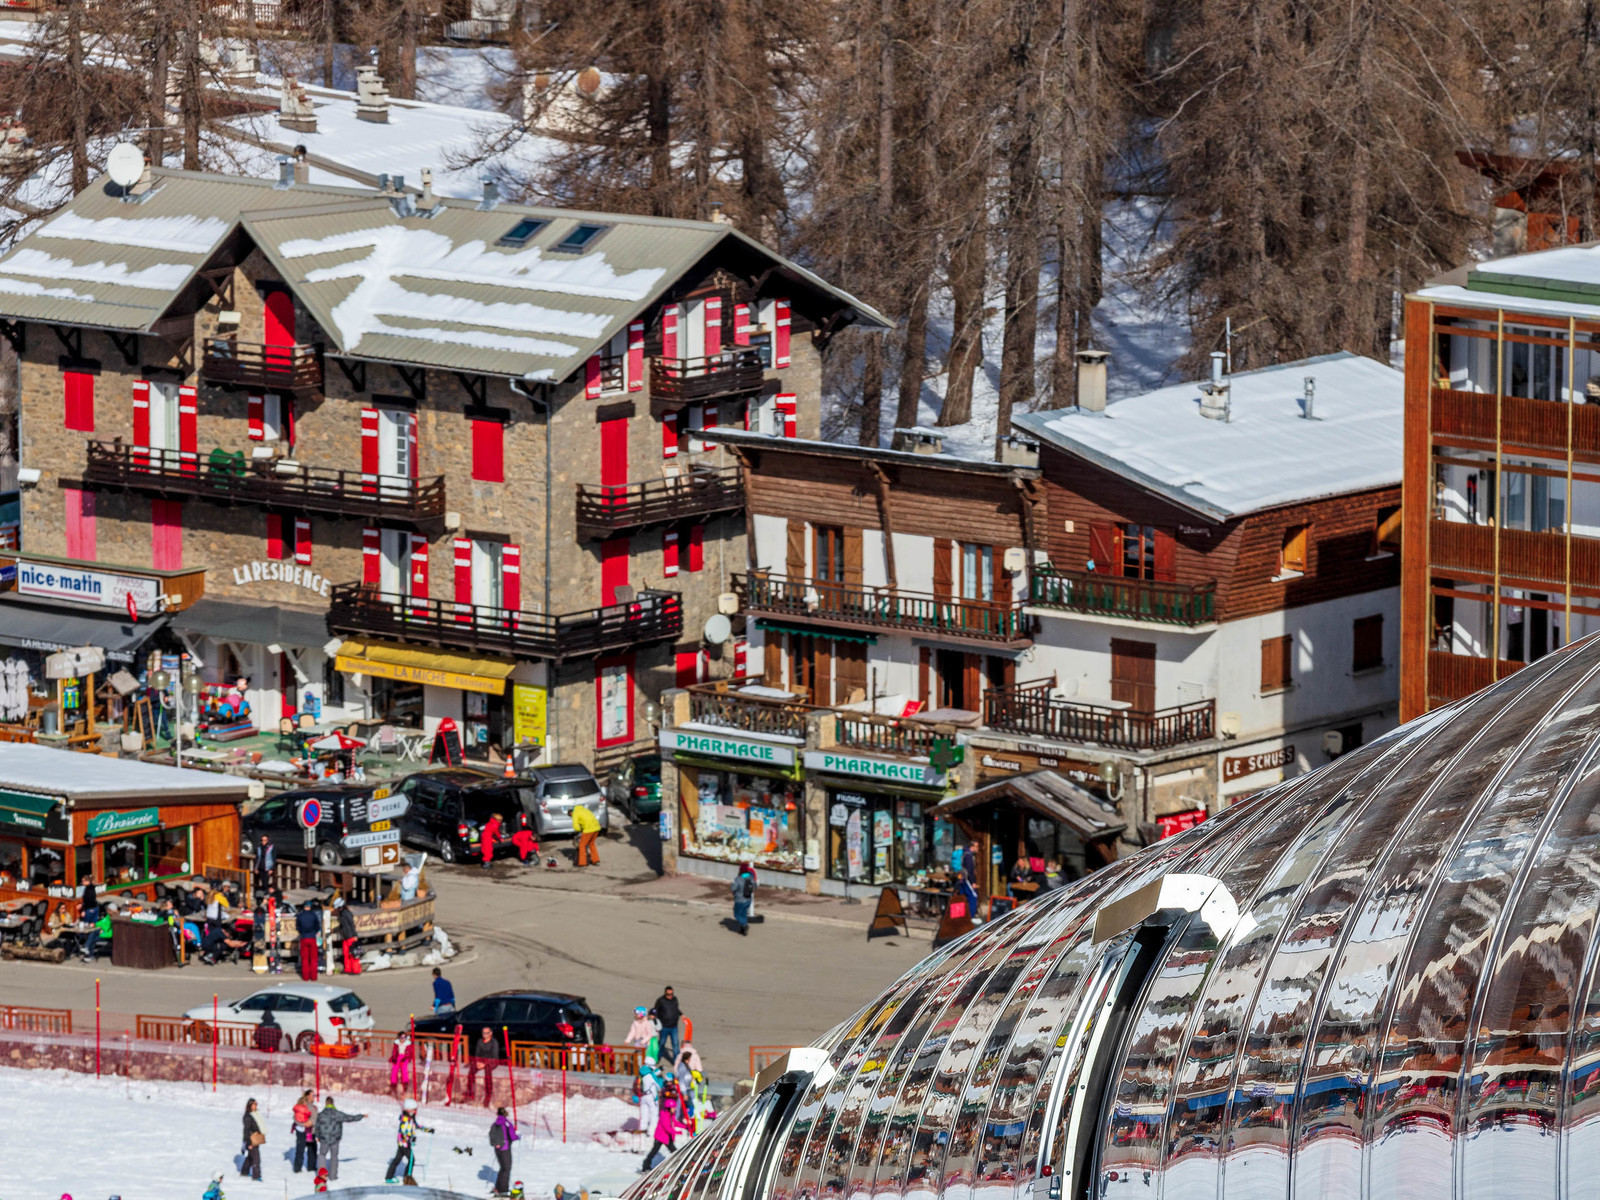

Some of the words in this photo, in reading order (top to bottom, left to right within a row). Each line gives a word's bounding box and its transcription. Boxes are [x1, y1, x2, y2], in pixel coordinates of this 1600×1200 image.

[233, 564, 253, 585] LA
[251, 561, 332, 597] RESIDENCE
[394, 666, 408, 678] LA
[412, 669, 447, 685] MICHE
[676, 734, 774, 760] PHARMACIE
[824, 755, 924, 781] PHARMACIE
[1226, 759, 1241, 777] LE
[1248, 747, 1293, 771] SCHUSS
[96, 813, 153, 832] Brasserie
